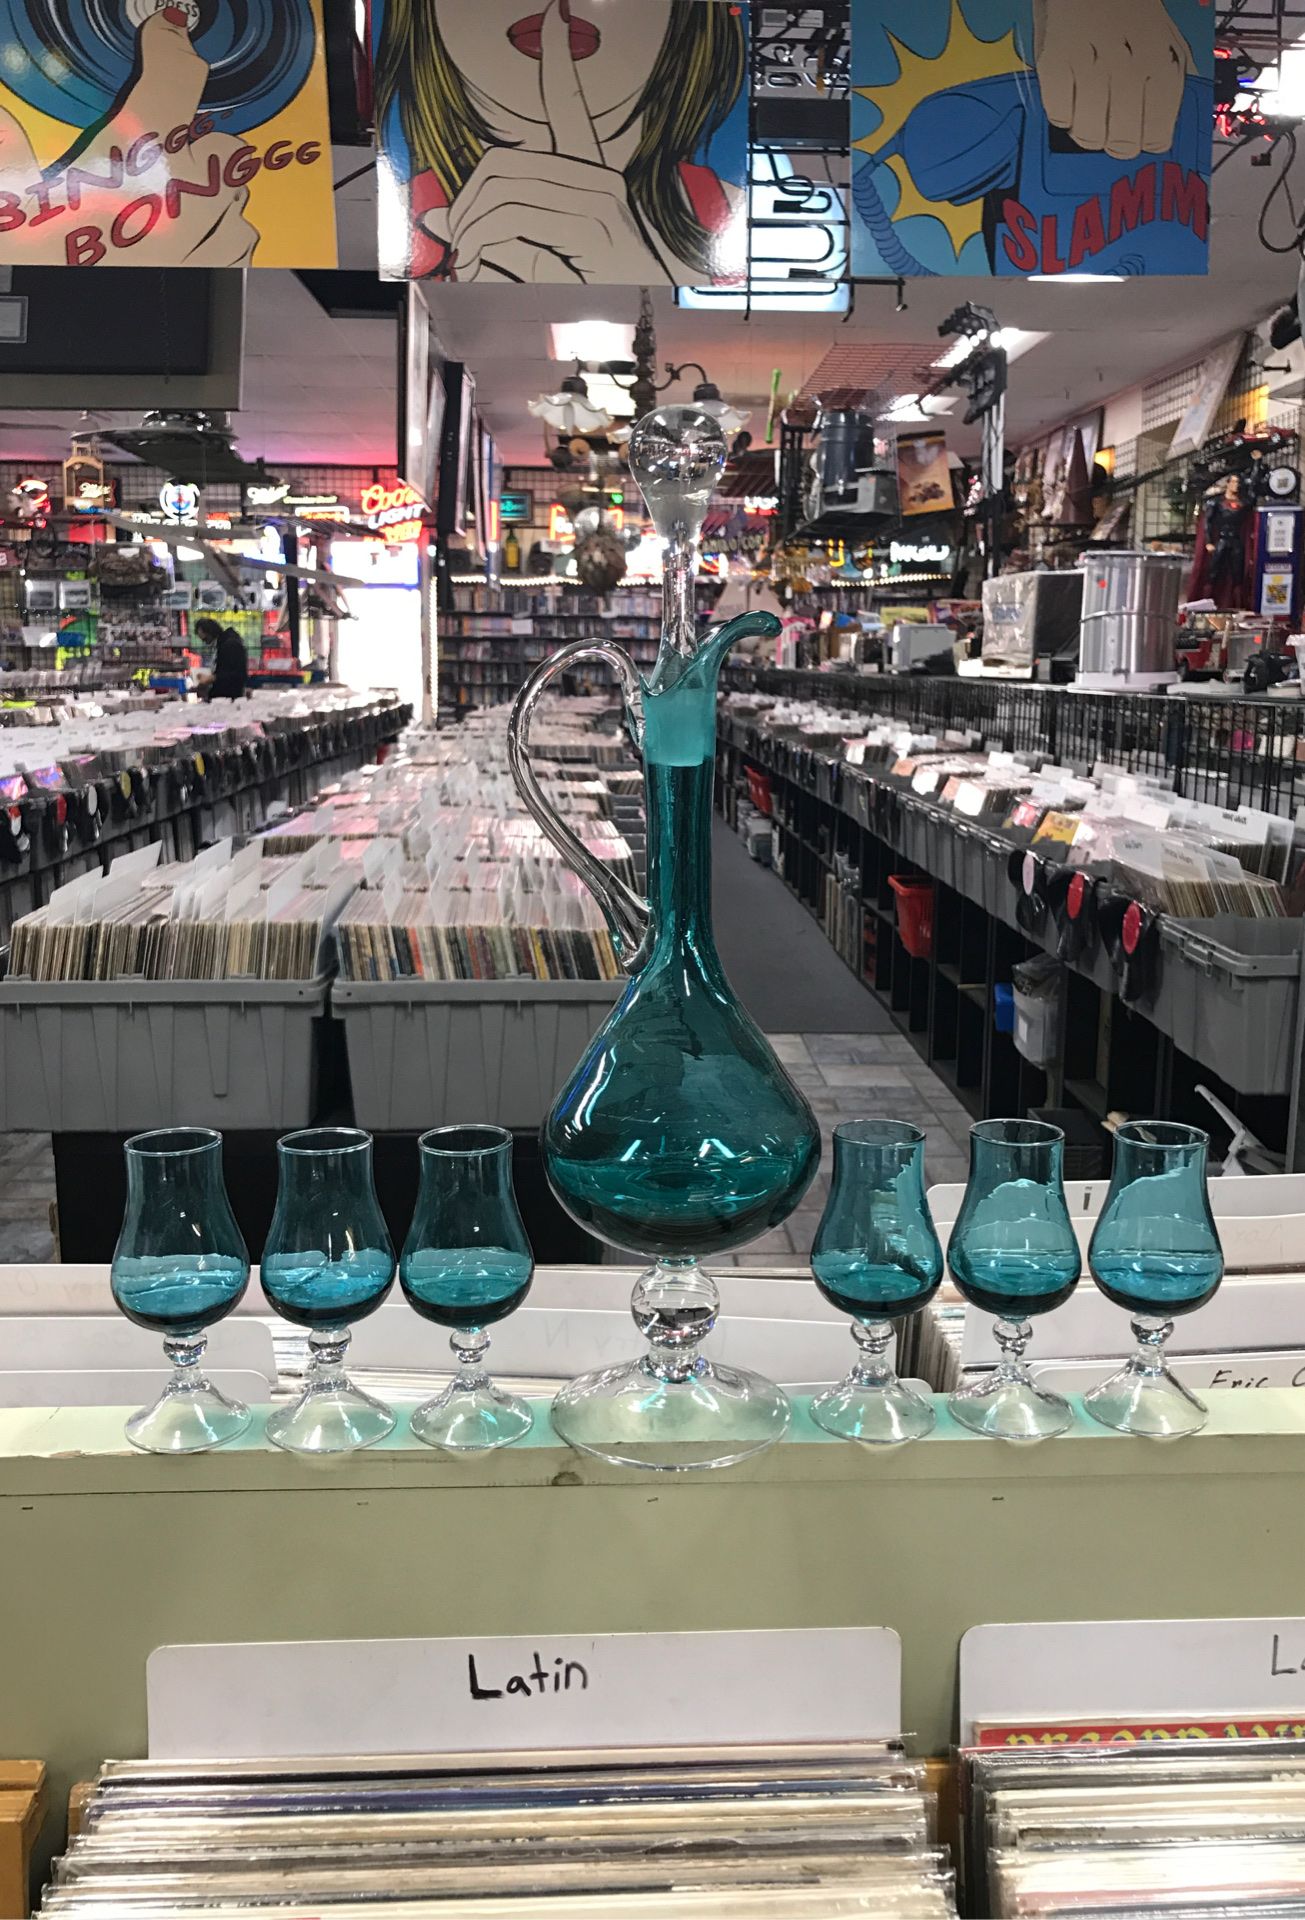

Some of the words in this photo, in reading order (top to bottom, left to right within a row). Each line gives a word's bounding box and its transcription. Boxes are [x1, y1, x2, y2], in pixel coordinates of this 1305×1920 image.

[65, 140, 322, 266] BONGGG
[1003, 163, 1207, 273] SLAMM
[367, 503, 425, 530] LIGHT
[468, 1651, 589, 1700] Latin
[1271, 1634, 1305, 1676] L
